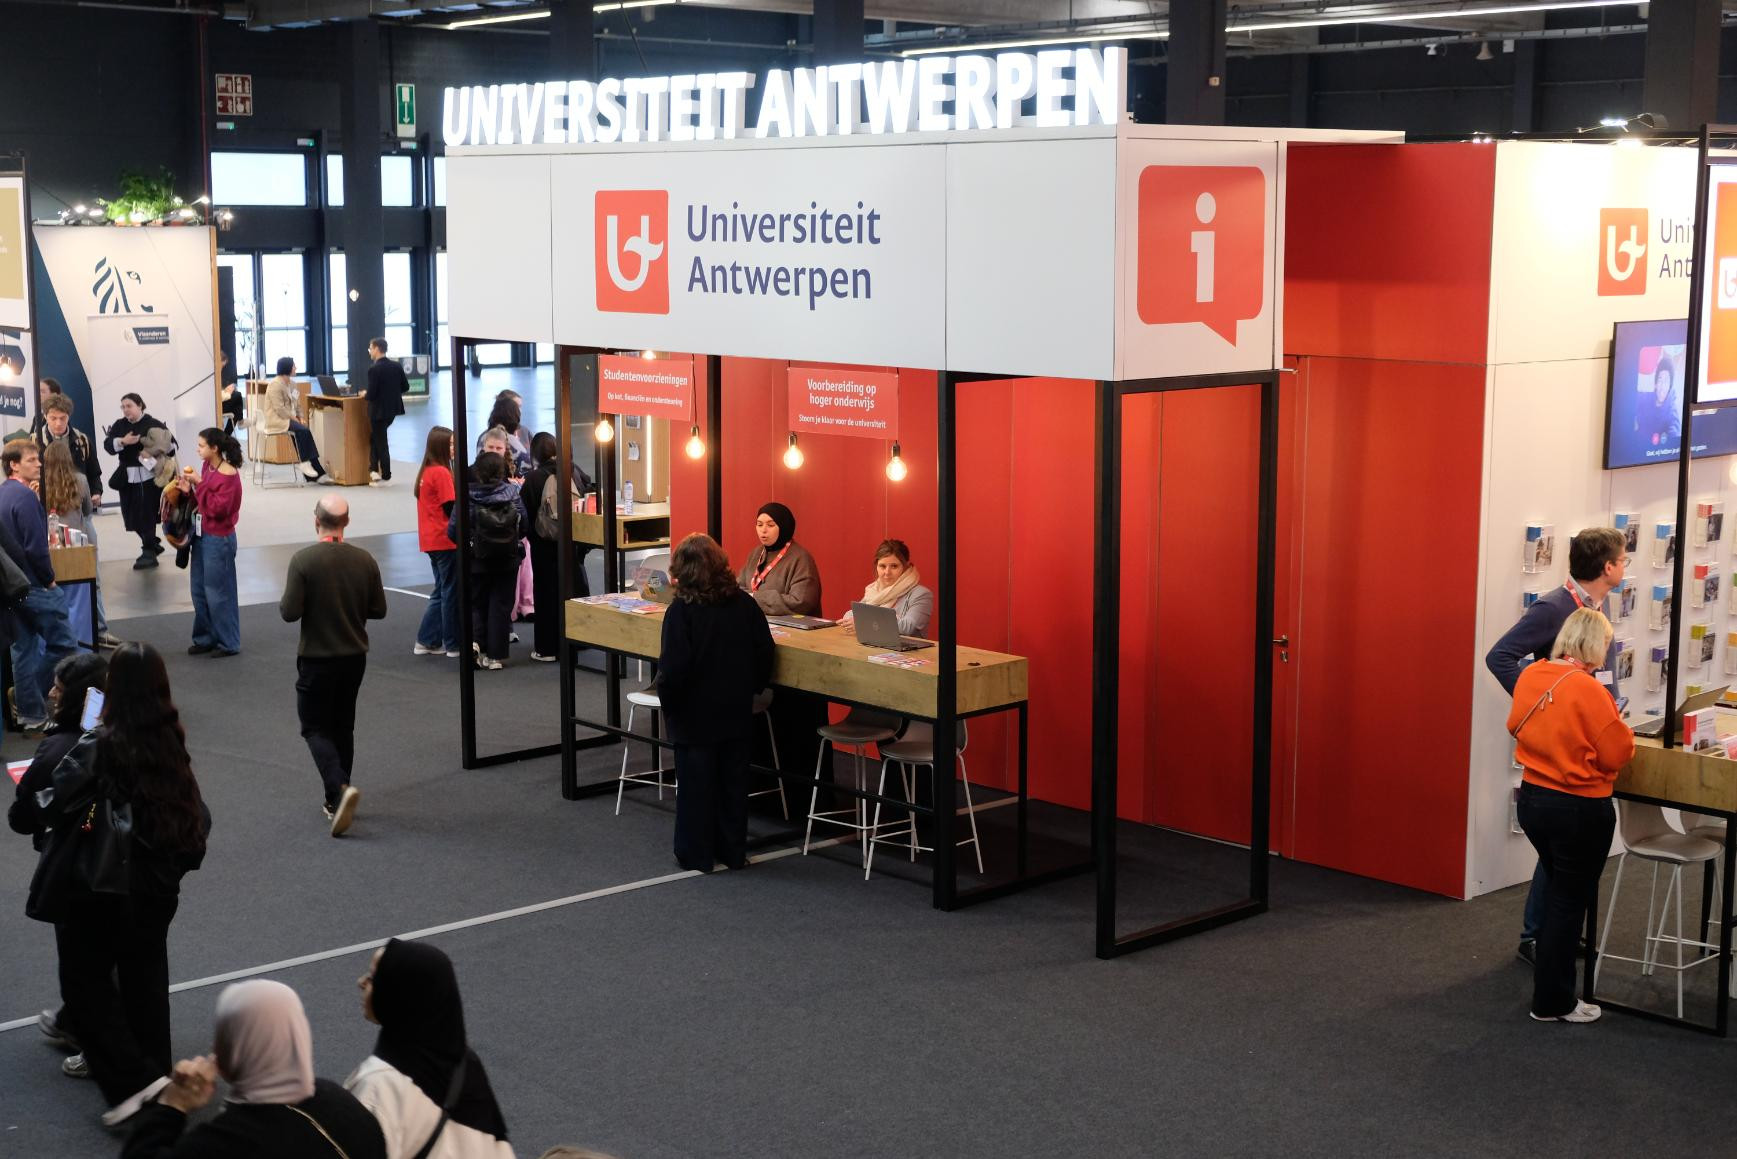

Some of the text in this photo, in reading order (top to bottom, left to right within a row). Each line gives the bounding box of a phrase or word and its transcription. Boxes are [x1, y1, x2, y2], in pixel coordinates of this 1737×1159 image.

[443, 46, 1127, 146] UNIVERSITEIT ANTWERPEN
[687, 201, 880, 245] Universiteit
[687, 256, 871, 311] Antwerpen
[603, 368, 688, 388] Studentenvoorzieningen
[807, 378, 876, 397] Voorbereiding op
[809, 393, 874, 412] hoger onderwijs
